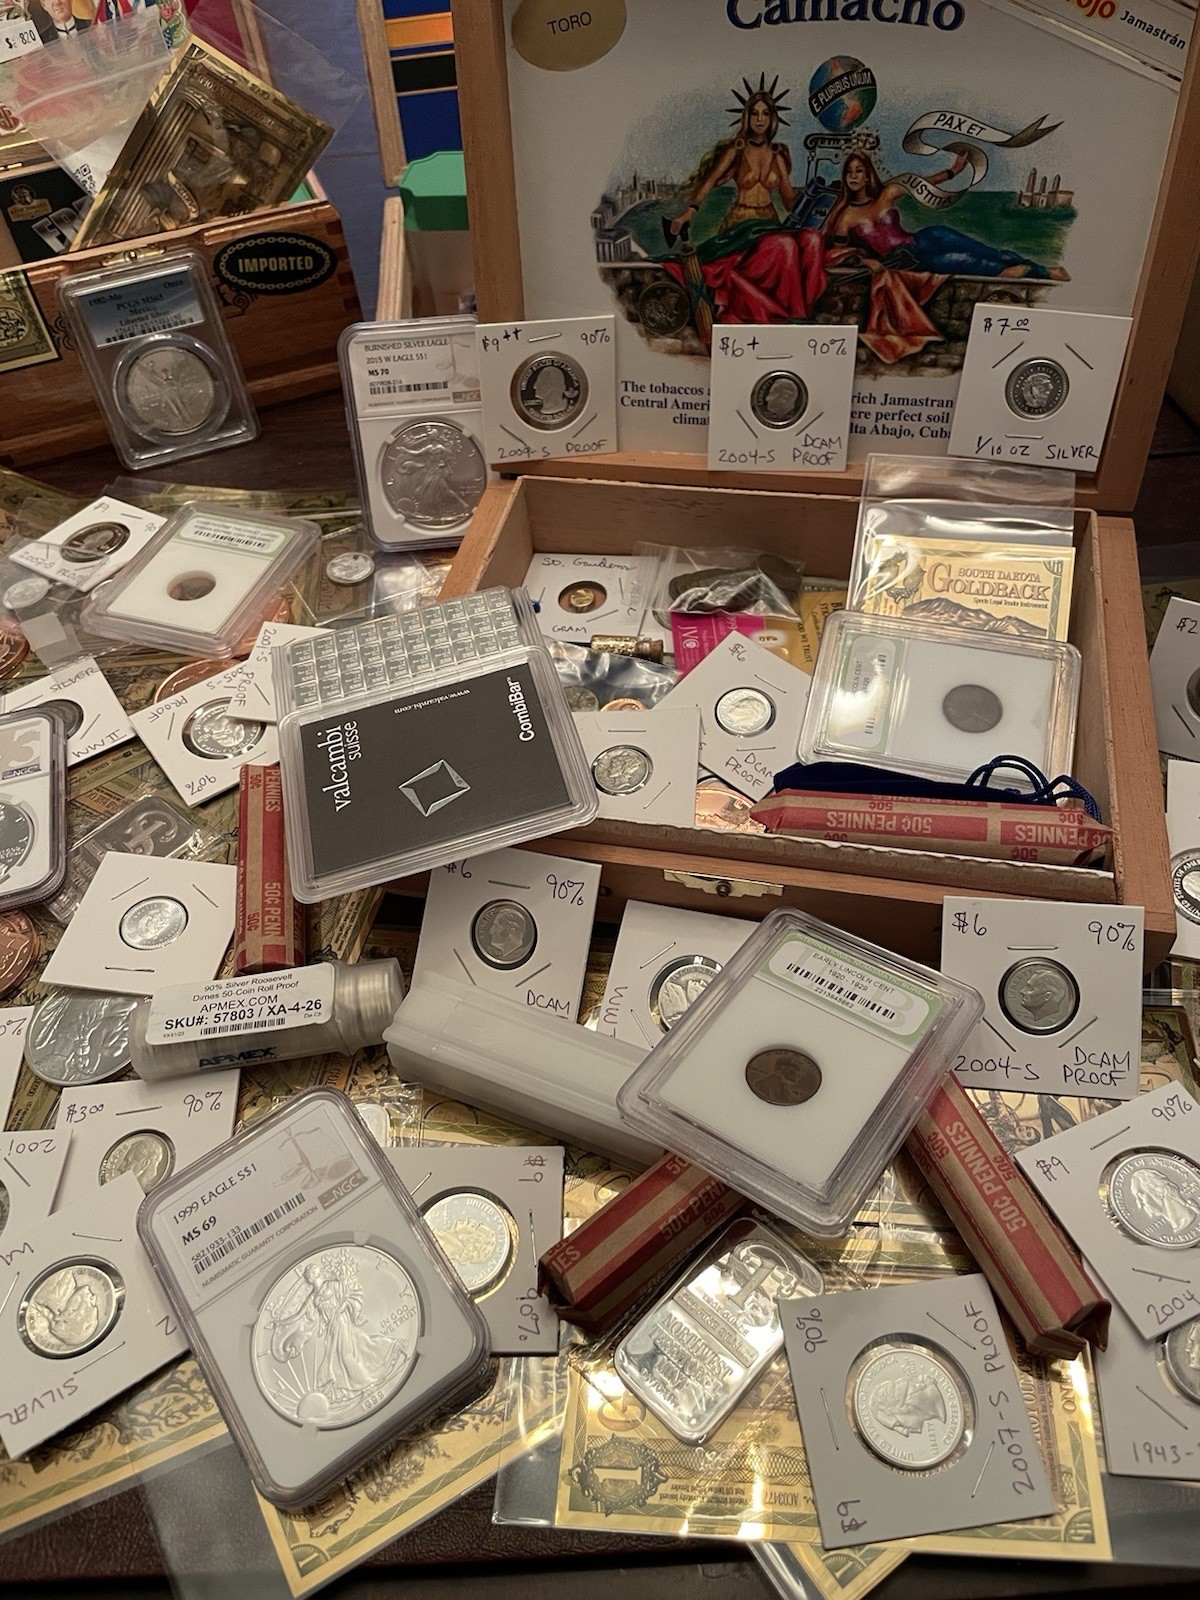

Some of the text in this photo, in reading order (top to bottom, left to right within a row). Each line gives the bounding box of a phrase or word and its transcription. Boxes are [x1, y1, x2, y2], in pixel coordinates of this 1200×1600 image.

[547, 11, 592, 36] TORO
[727, 0, 965, 31] Camacho
[1119, 10, 1187, 50] Jamastrán
[933, 113, 987, 137] PAX ET
[238, 251, 314, 273] IMPORTED
[364, 338, 449, 353] BURNISHED SILVER EAGLE
[580, 328, 611, 346] 90%
[806, 338, 848, 357] 90%
[383, 355, 392, 363] W
[392, 353, 415, 363] EAGLE
[368, 368, 390, 377] MS 70
[621, 380, 704, 397] The tobaccos
[850, 391, 955, 411] rich Jamastran
[620, 394, 669, 411] Central
[874, 408, 924, 427] perfect
[925, 409, 951, 424] soil
[800, 433, 842, 450] DCAM
[870, 423, 916, 441] Abajo,
[565, 438, 608, 455] PROOF
[791, 446, 837, 467] PROOF
[1045, 442, 1100, 461] SILVER
[927, 561, 1052, 602] GOLDBACK
[958, 567, 1042, 584] SOUTH DAKOTA
[551, 624, 588, 635] GRAM
[149, 694, 188, 723] PROOF
[394, 688, 471, 715] www.valcambi.com
[507, 679, 535, 742] CombiBar
[345, 720, 362, 761] suisse
[316, 725, 353, 812] valcambi
[725, 756, 766, 788] PROOF
[184, 774, 217, 796] 90%
[265, 765, 281, 813] PENNIES
[826, 811, 934, 834] 50¢ PENNIES
[1014, 823, 1089, 846] PENNIES
[546, 873, 585, 906] 90%
[951, 911, 988, 938] $6
[1087, 920, 1136, 952] 90%
[204, 973, 293, 992] 90% Silver Roosevelt
[812, 952, 896, 995] EARLY LINCOLN CENT
[828, 969, 869, 992] 1920 1929
[192, 980, 300, 1002] Dimes 50-Coin Roll Proof
[200, 994, 278, 1014] APMEX.COM
[526, 989, 570, 1015] DCAM
[164, 1015, 209, 1031] SKU#:
[213, 1007, 255, 1025] 57803
[265, 998, 323, 1017] XA-4-26
[199, 1046, 277, 1068] APMEX
[1073, 1045, 1131, 1072] DCAM
[954, 1055, 1128, 1087] 2004-S PROOF
[183, 1091, 223, 1118] 90%
[1151, 1094, 1193, 1123] 90%
[945, 1120, 1027, 1234] 50¢ PENNIES
[1035, 1155, 1070, 1182] $9
[173, 1162, 258, 1225] 1999 EAGLE S$1
[332, 1176, 361, 1200] NGC
[182, 1214, 218, 1246] MS 69
[191, 1225, 242, 1264] 5821933-133
[201, 1206, 318, 1289] NUMISMATIC GUARANTY CORPORATION
[516, 1287, 542, 1342] 90%
[796, 1308, 828, 1353] 90%
[962, 1300, 1005, 1374] PROOF
[660, 1312, 735, 1382] NORTHWEST
[835, 1499, 868, 1533] $9
